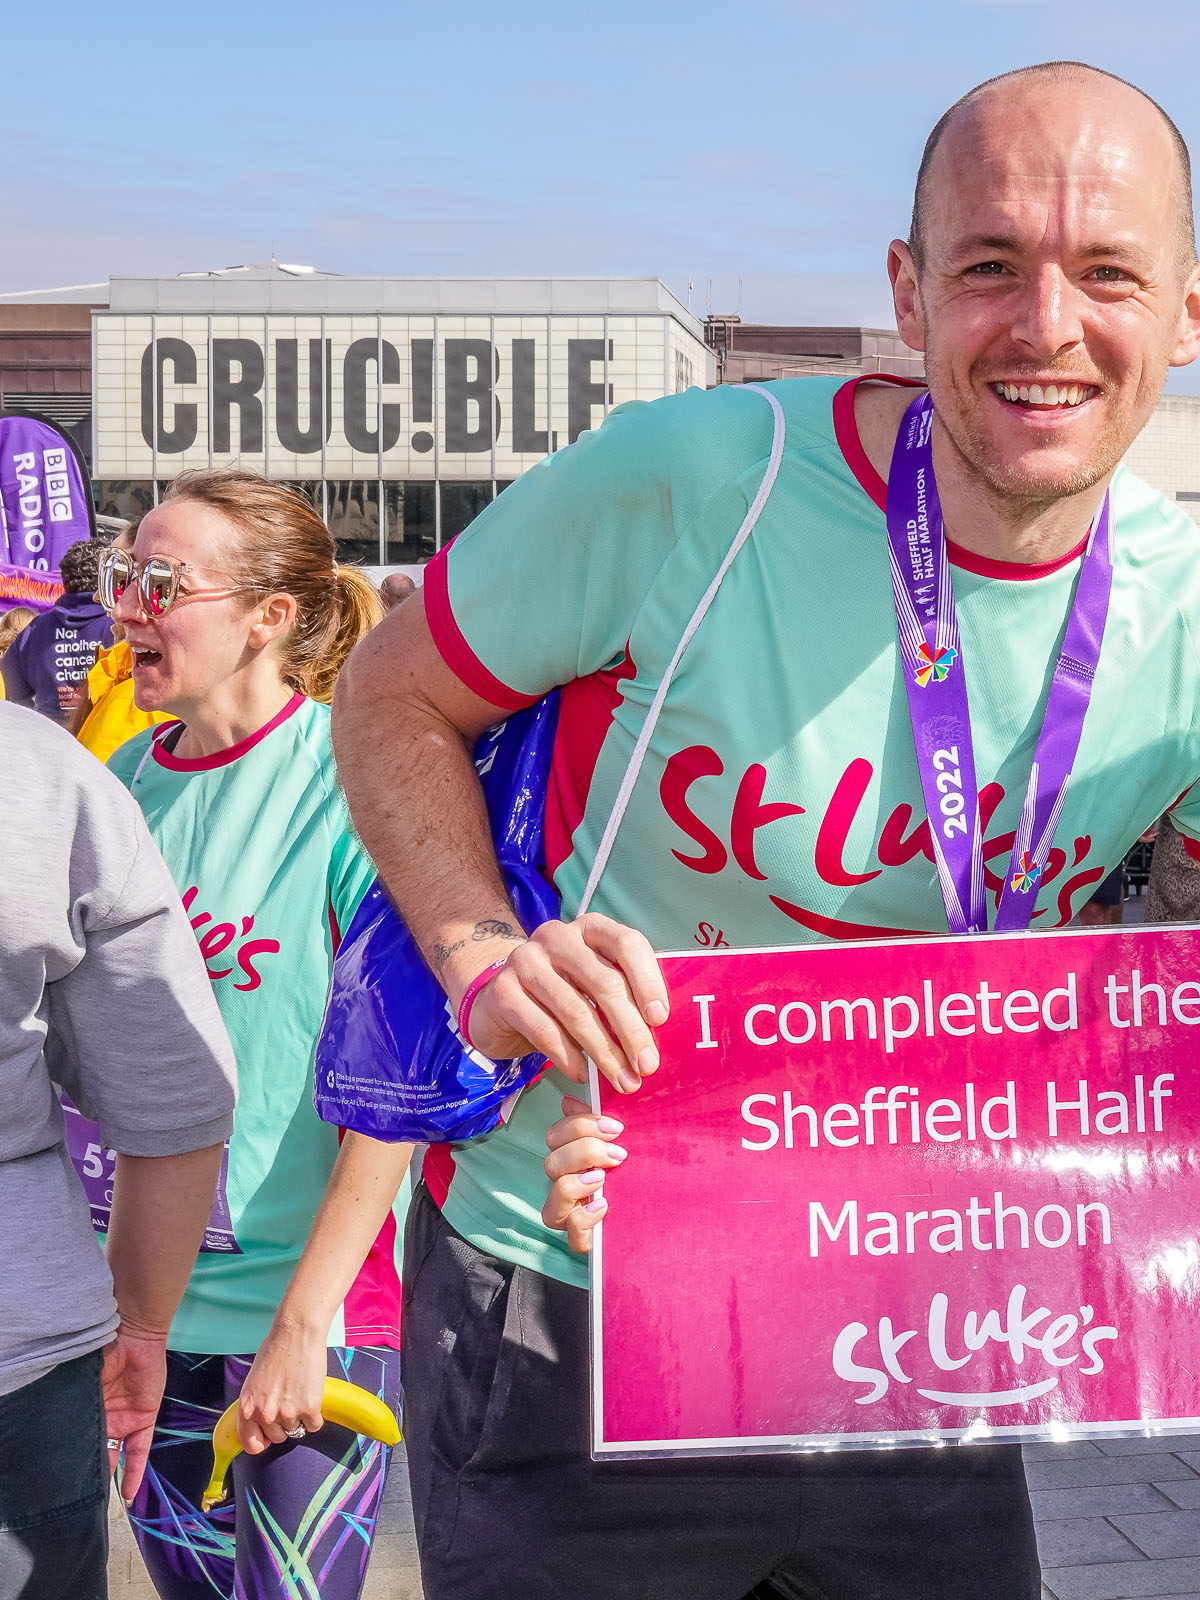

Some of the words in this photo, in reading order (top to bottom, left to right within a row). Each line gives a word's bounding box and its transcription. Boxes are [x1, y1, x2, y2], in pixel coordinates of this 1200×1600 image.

[13, 452, 45, 553] RADIO
[44, 449, 72, 521] BBC
[917, 467, 931, 546] MARATHON
[907, 519, 924, 581] SHEFFIELD
[921, 546, 935, 579] HALF
[55, 640, 102, 653] another
[56, 628, 78, 639] Not
[56, 668, 89, 681] chari
[660, 746, 806, 881] St
[933, 746, 968, 838] 2022
[692, 994, 719, 1049] I
[744, 972, 1079, 1053] completed
[414, 1104, 445, 1115] Tomlinson
[446, 1098, 469, 1109] Appeal
[741, 1082, 1017, 1151] Sheffield
[1047, 1073, 1175, 1137] Half
[92, 1218, 107, 1227] ALL
[809, 1191, 1112, 1258] Marathon
[832, 1316, 918, 1405] St
[928, 1284, 1119, 1376] Luke's
